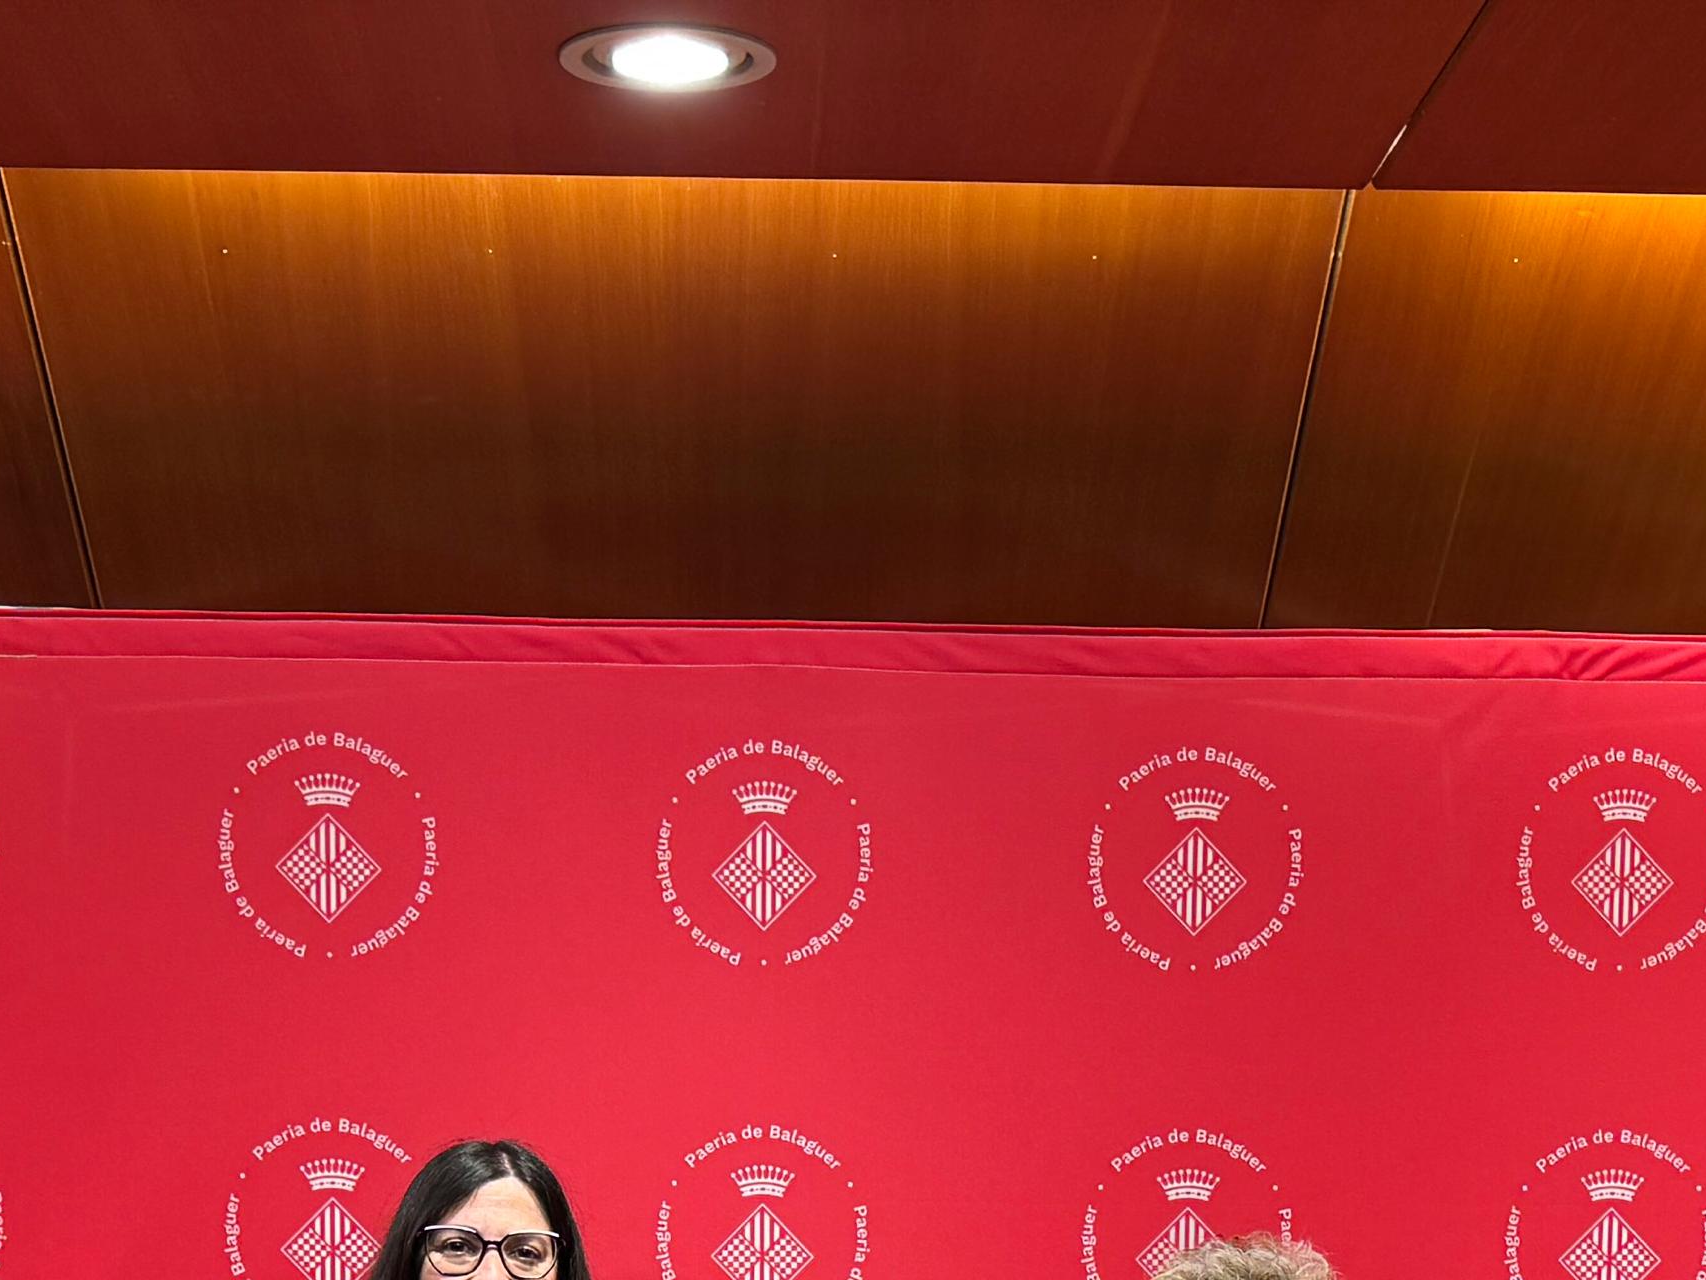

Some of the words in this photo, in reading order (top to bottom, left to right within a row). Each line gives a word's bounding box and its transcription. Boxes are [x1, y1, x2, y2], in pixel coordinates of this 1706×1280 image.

[247, 739, 300, 775] Paeria
[305, 731, 326, 746] de
[334, 732, 408, 778] Balaguer
[686, 747, 738, 784] Paeria
[743, 739, 764, 755] de
[772, 740, 843, 785] Balaguer
[1119, 755, 1172, 790] Paeria
[1177, 747, 1197, 761] de
[1205, 747, 1276, 791] Balaguer
[1548, 755, 1600, 792] Paeria
[1605, 747, 1625, 763] de
[1632, 748, 1702, 793] Balaguer
[252, 1125, 305, 1160] Paeria
[310, 1117, 331, 1133] de
[339, 1118, 412, 1163] Balaguer
[684, 1132, 737, 1168] Paeria
[742, 1124, 762, 1139] de
[770, 1125, 841, 1168] Balaguer
[1111, 1136, 1163, 1172] Paeria
[1168, 1128, 1189, 1143] de
[1196, 1129, 1266, 1172] Balaguer
[1536, 1137, 1588, 1173] Paeria
[1593, 1129, 1613, 1144] de
[1621, 1129, 1690, 1172] Balaguer
